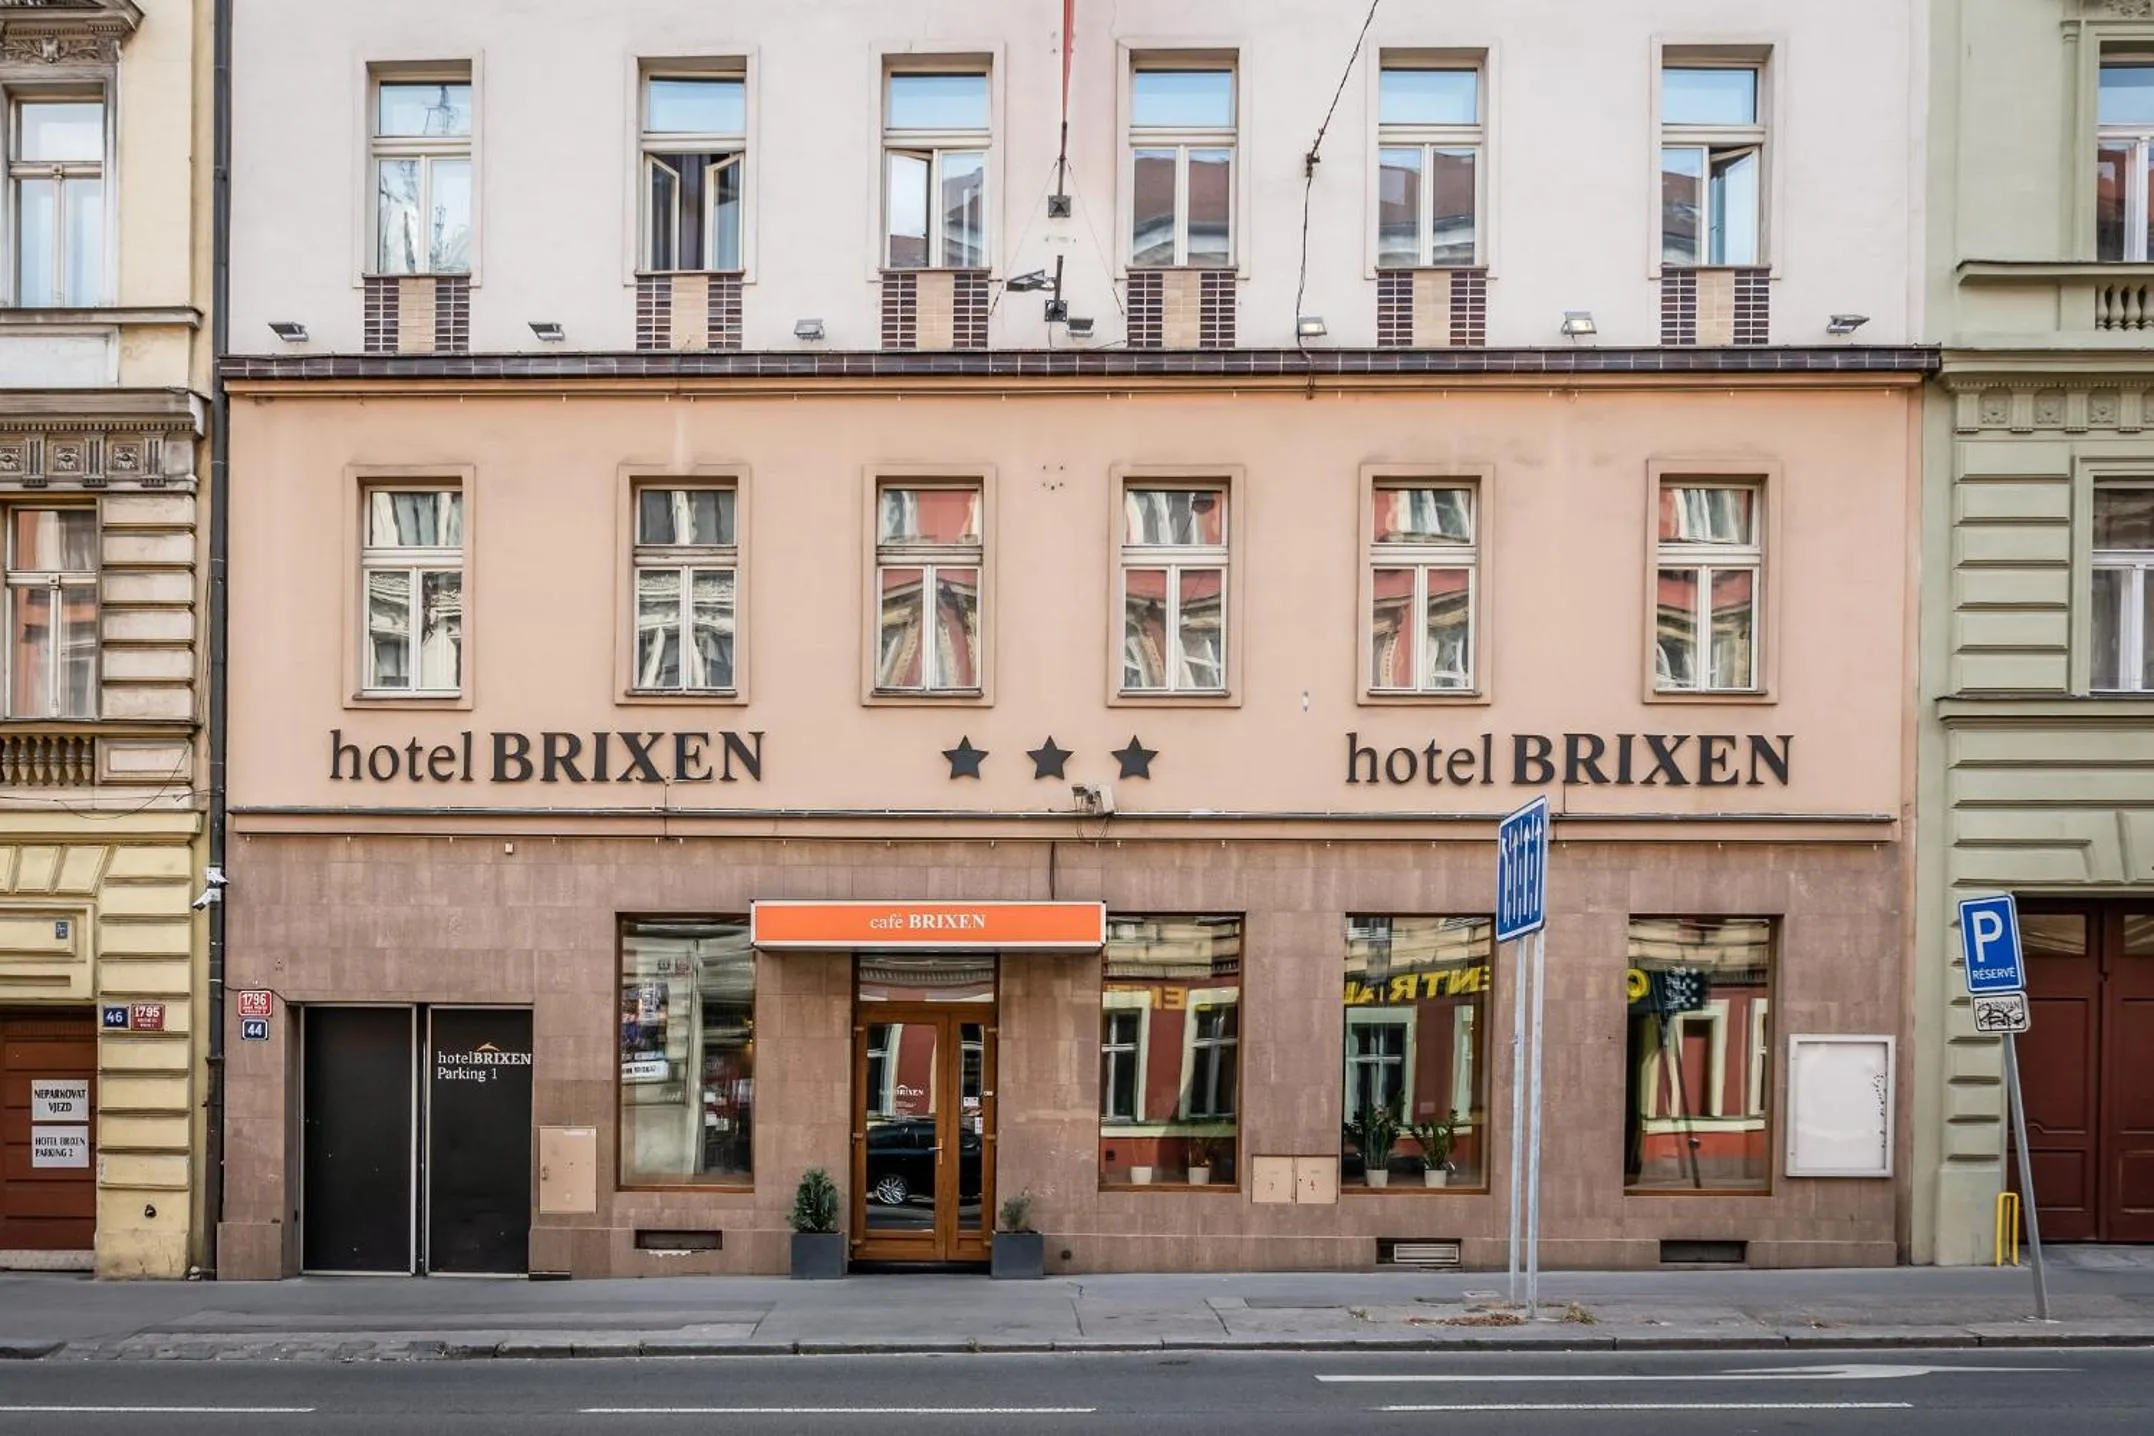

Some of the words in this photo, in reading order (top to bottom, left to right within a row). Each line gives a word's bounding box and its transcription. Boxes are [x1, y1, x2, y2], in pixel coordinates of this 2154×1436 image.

[329, 729, 475, 783] hotel
[489, 730, 766, 783] BRIXEN
[1345, 731, 1495, 785] hotel
[1511, 732, 1795, 786] BRIXEN
[908, 912, 986, 929] BRIXEN
[1972, 910, 2003, 963] P
[242, 993, 267, 1006] 1796
[106, 1011, 123, 1023] 46
[134, 1006, 160, 1018] 1795
[247, 1023, 262, 1036] 44
[437, 1067, 486, 1082] Parking
[491, 1068, 498, 1080] 1
[34, 1089, 86, 1099] NEPARKOVAT
[48, 1102, 73, 1114] VJEZD
